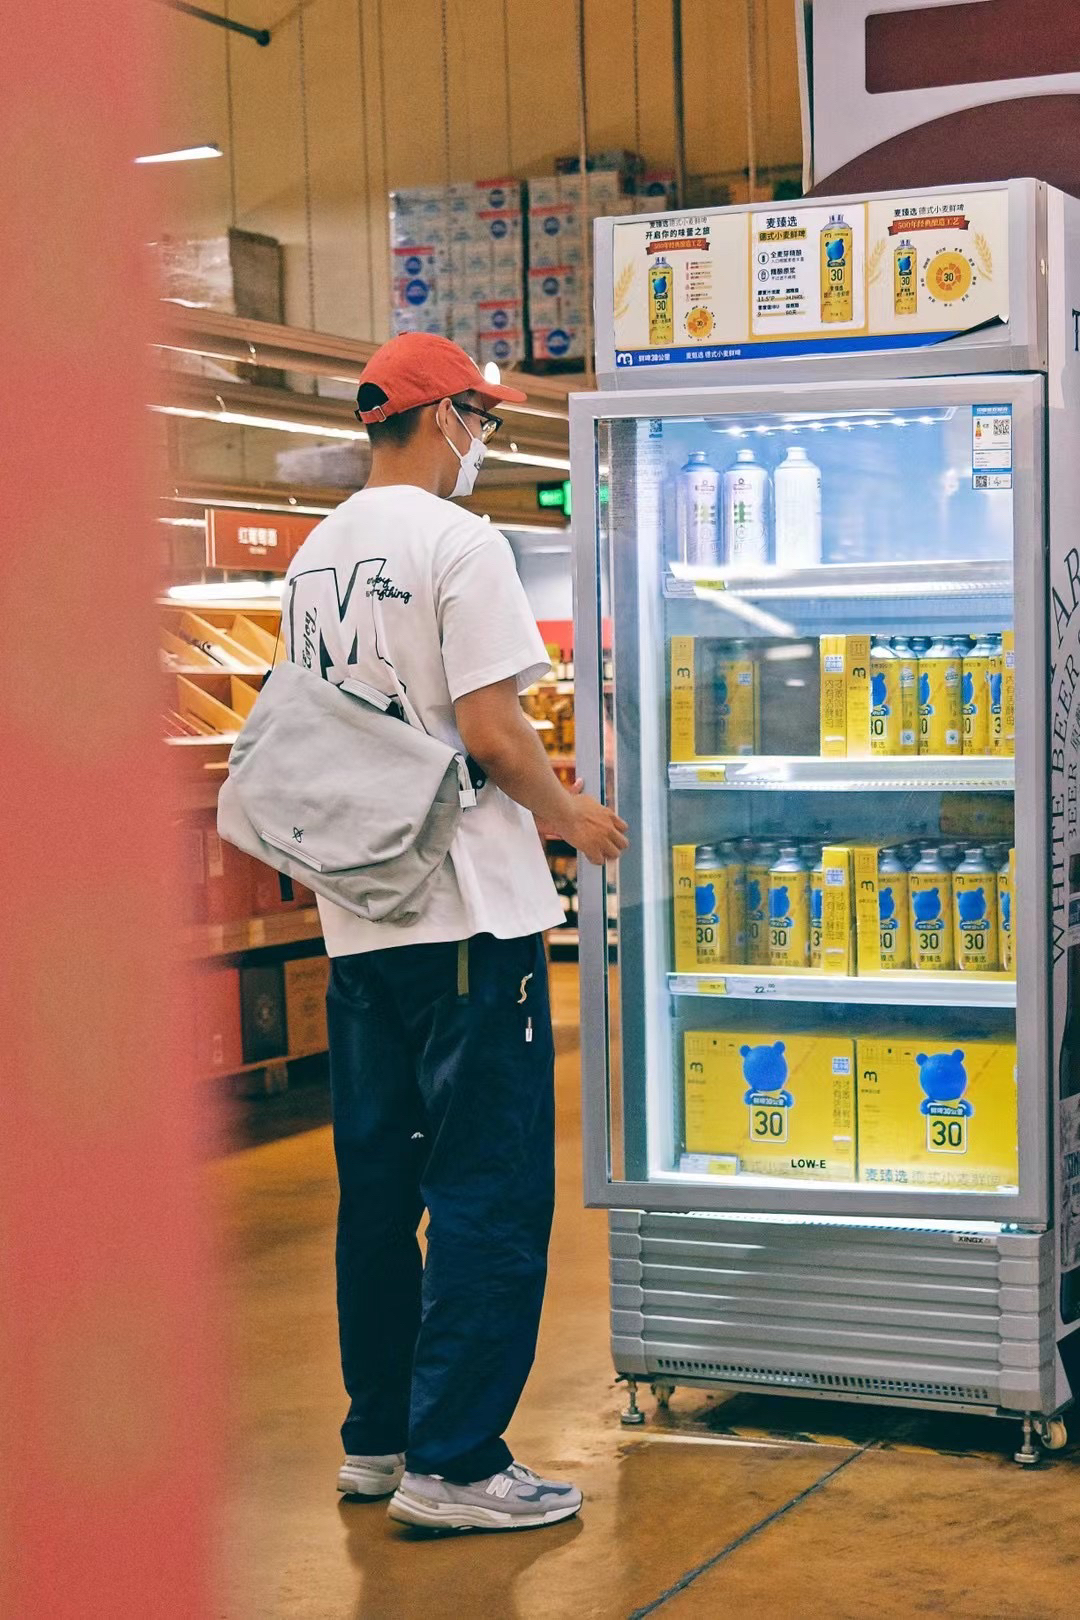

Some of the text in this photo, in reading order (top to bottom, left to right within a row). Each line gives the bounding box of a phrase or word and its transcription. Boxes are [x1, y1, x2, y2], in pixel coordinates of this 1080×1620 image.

[766, 216, 798, 229] 麦臻选
[645, 226, 710, 240] 开启你的味蕾之旅
[759, 230, 806, 242] 德式小麦鲜啤
[831, 268, 843, 282] 30
[901, 276, 910, 286] 30
[943, 272, 954, 282] 30
[656, 300, 667, 311] 30
[1052, 654, 1080, 780] BEER
[994, 717, 1001, 734] 3
[696, 927, 714, 943] 30
[770, 930, 787, 946] 30
[813, 931, 822, 947] 3
[919, 933, 939, 950] 30
[964, 933, 984, 950] 30
[755, 1110, 783, 1137] 30
[932, 1120, 962, 1147] 30
[791, 1159, 826, 1169] LOW-E
[866, 1167, 909, 1184] 麦臻选
[486, 1475, 514, 1499] N
